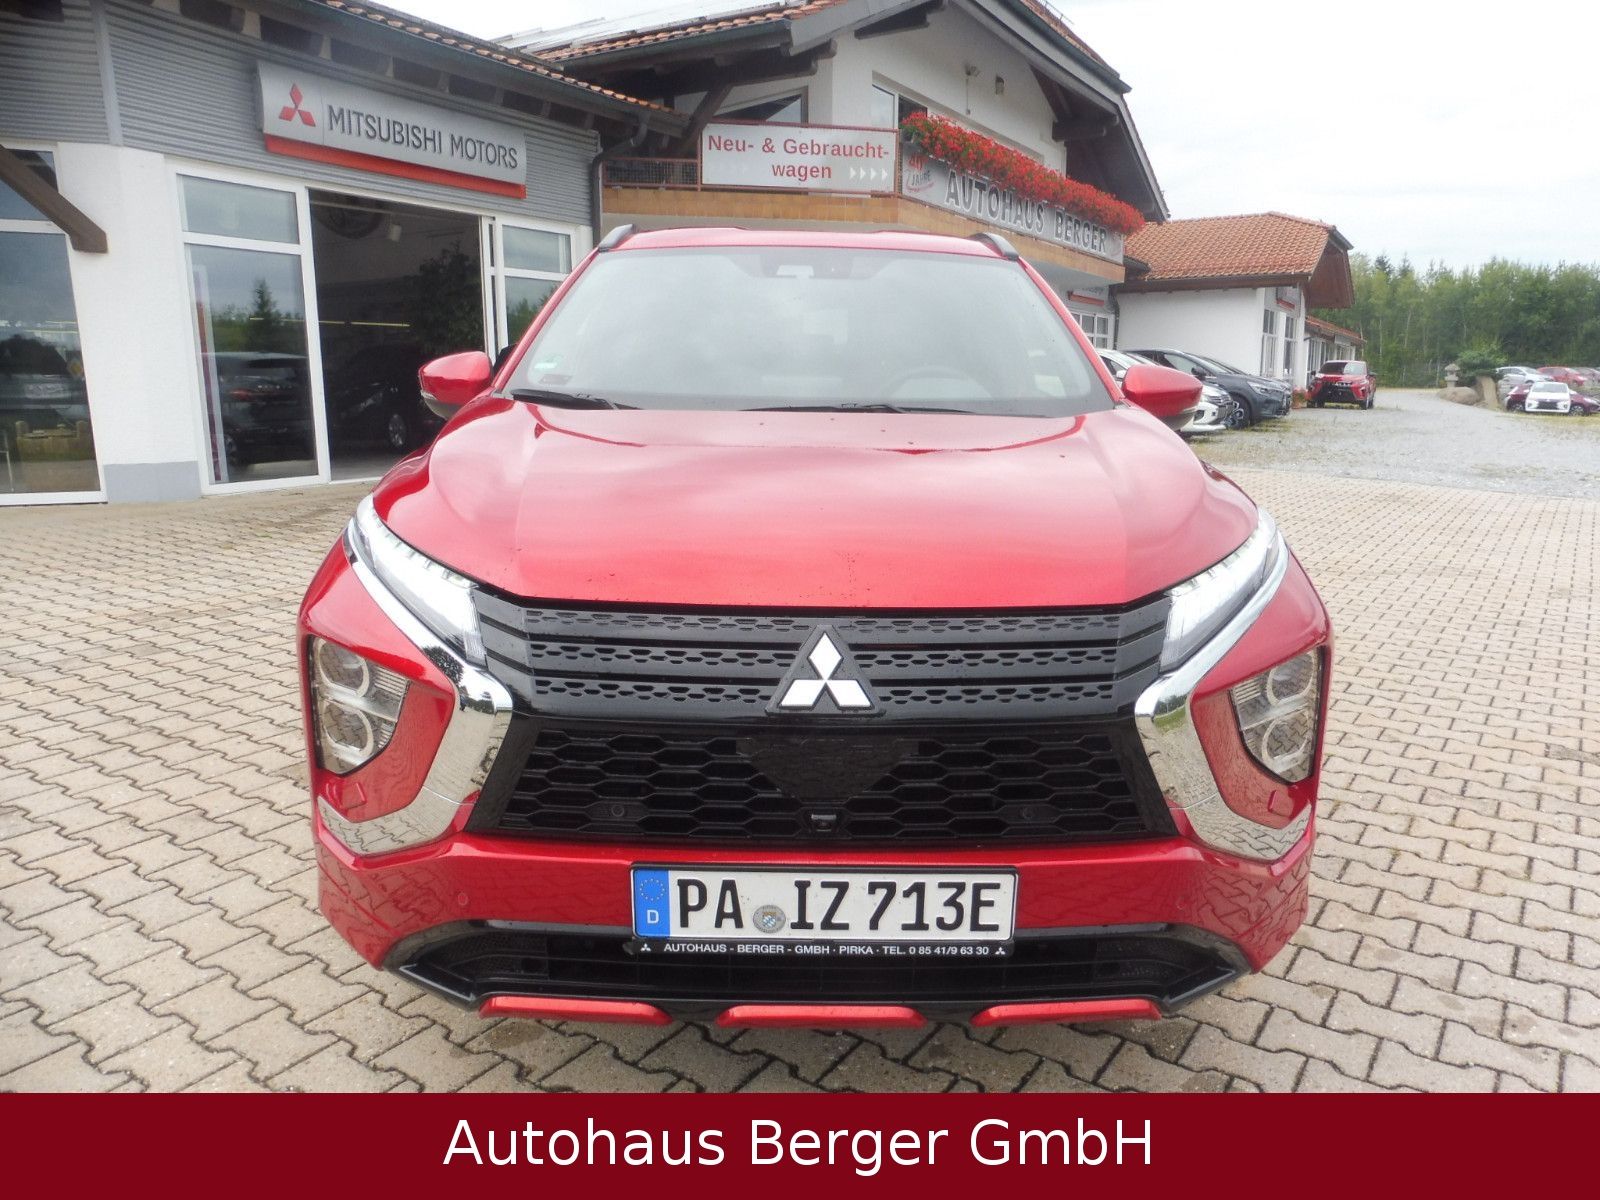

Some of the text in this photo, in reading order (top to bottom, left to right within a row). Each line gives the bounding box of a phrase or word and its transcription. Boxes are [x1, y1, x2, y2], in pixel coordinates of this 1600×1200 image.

[328, 105, 518, 169] MITSUBISHI MOTORS
[708, 135, 889, 159] Neu- & Gebraucht-
[772, 163, 832, 182] wagen
[944, 168, 1107, 255] AUTOHAUS BERGER
[646, 909, 659, 924] D
[677, 878, 744, 929] PA
[790, 880, 850, 931] IZ
[867, 881, 1001, 932] 713E
[663, 943, 727, 953] AUTOHAUS
[737, 944, 785, 954] BERGER
[794, 944, 830, 954] GMBH
[839, 945, 874, 955] PIRKA
[882, 945, 906, 955] TEL.
[918, 946, 932, 955] 85
[933, 946, 958, 955] 41/9
[960, 946, 974, 955] 63
[975, 946, 990, 955] 30
